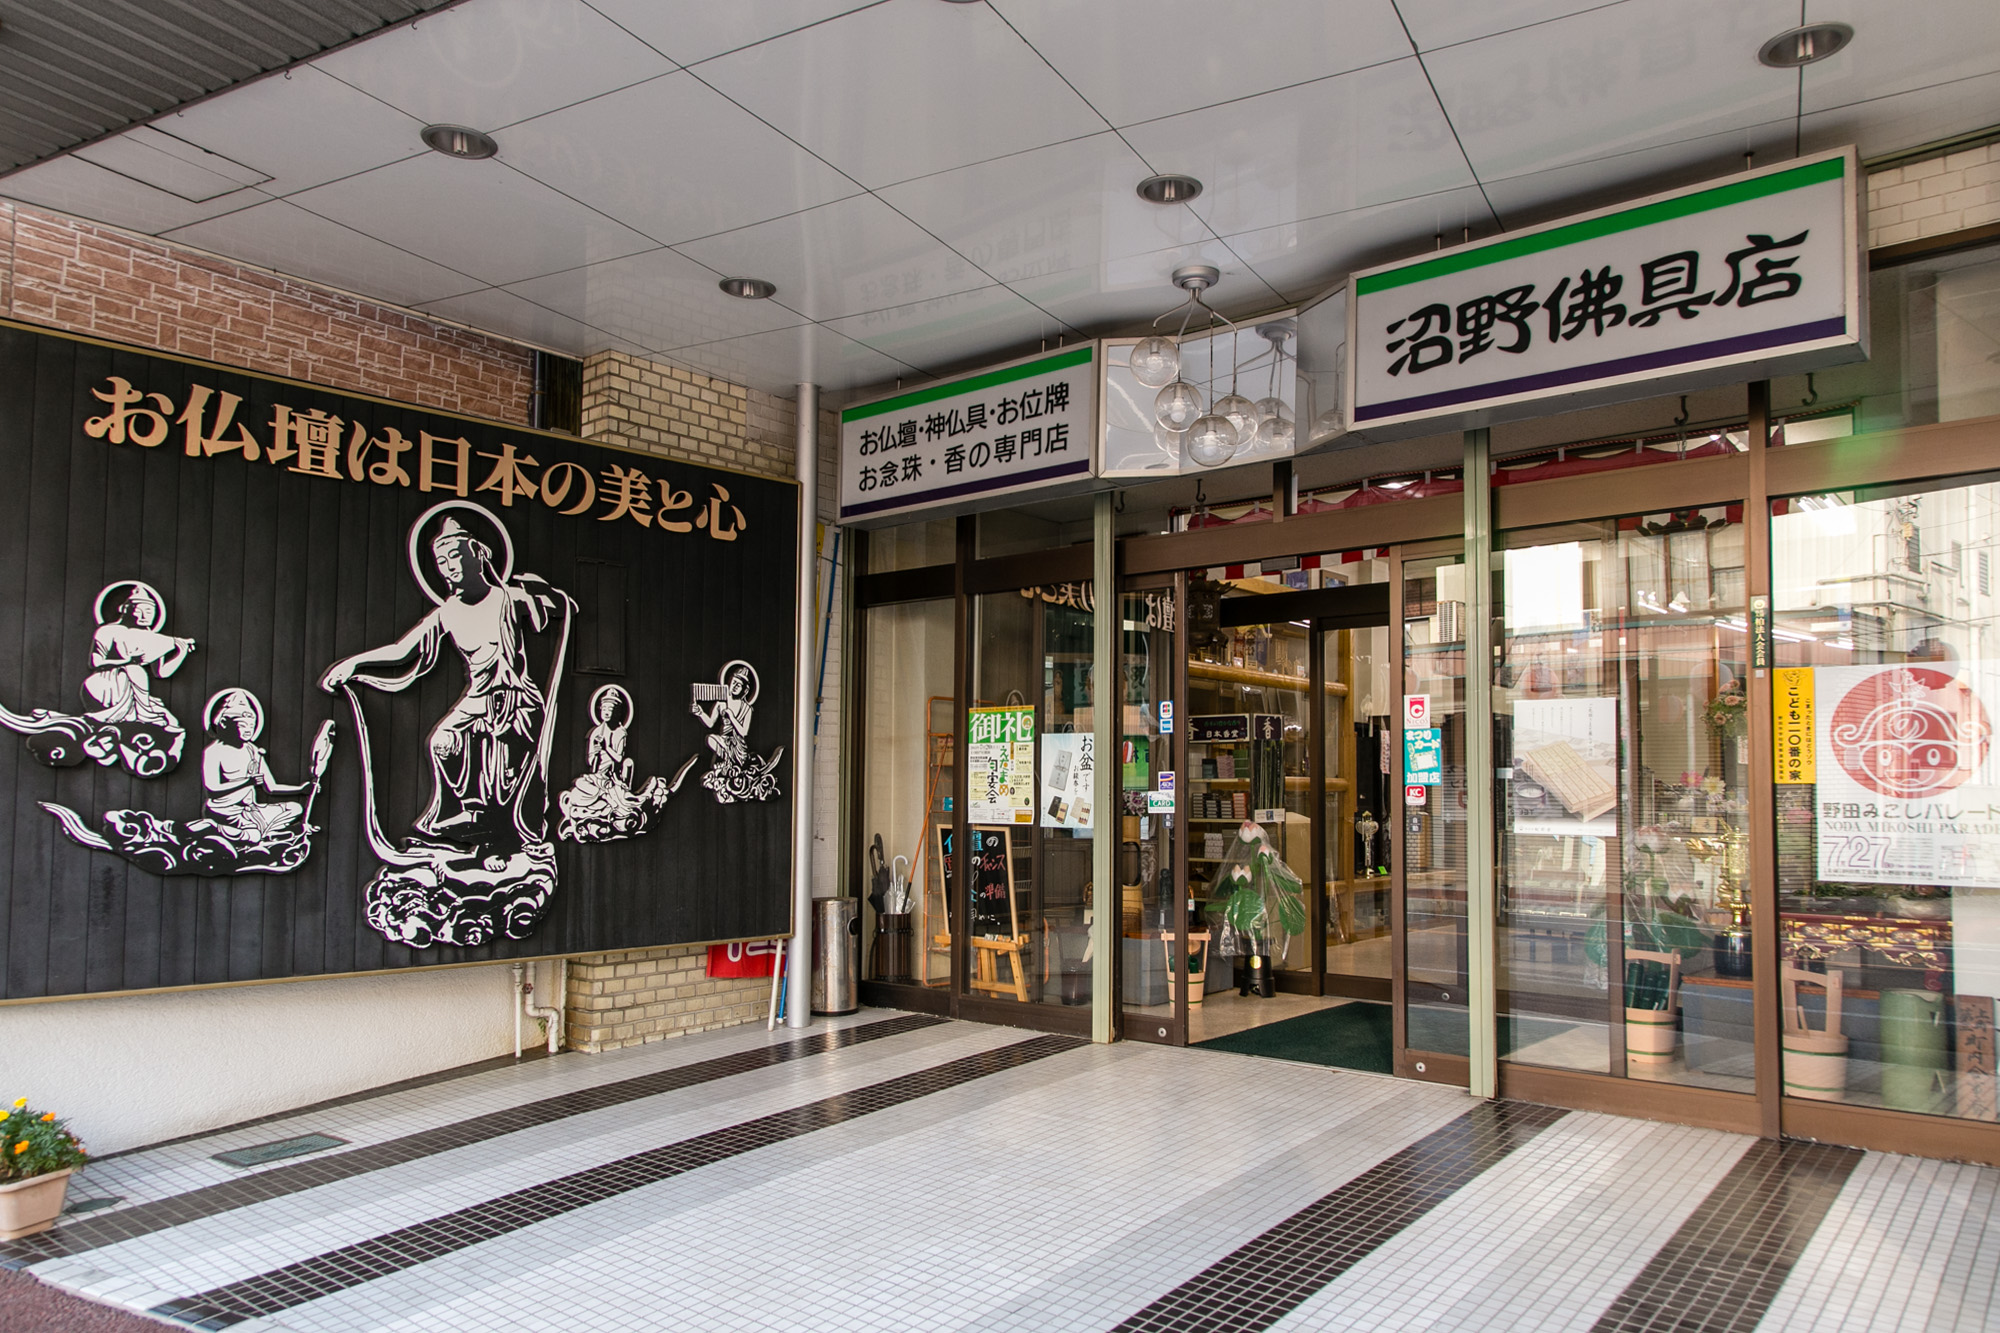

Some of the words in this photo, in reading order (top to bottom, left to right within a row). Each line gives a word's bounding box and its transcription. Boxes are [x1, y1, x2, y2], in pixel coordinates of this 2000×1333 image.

[1386, 229, 1810, 377] 沼野佛具店
[859, 381, 1070, 456] お仏壇・神仏具・お位牌
[84, 376, 748, 541] お仏壇は日本の美と心
[858, 423, 1070, 492] お念珠・香の専門店
[969, 711, 1033, 743] 御礼
[1262, 716, 1274, 740] 香
[1080, 734, 1094, 792] お盆です
[1406, 771, 1440, 784] 加盟店
[1152, 799, 1171, 808] CARD
[1824, 821, 1861, 833] NODA
[1867, 822, 1934, 833] MIKOSHI
